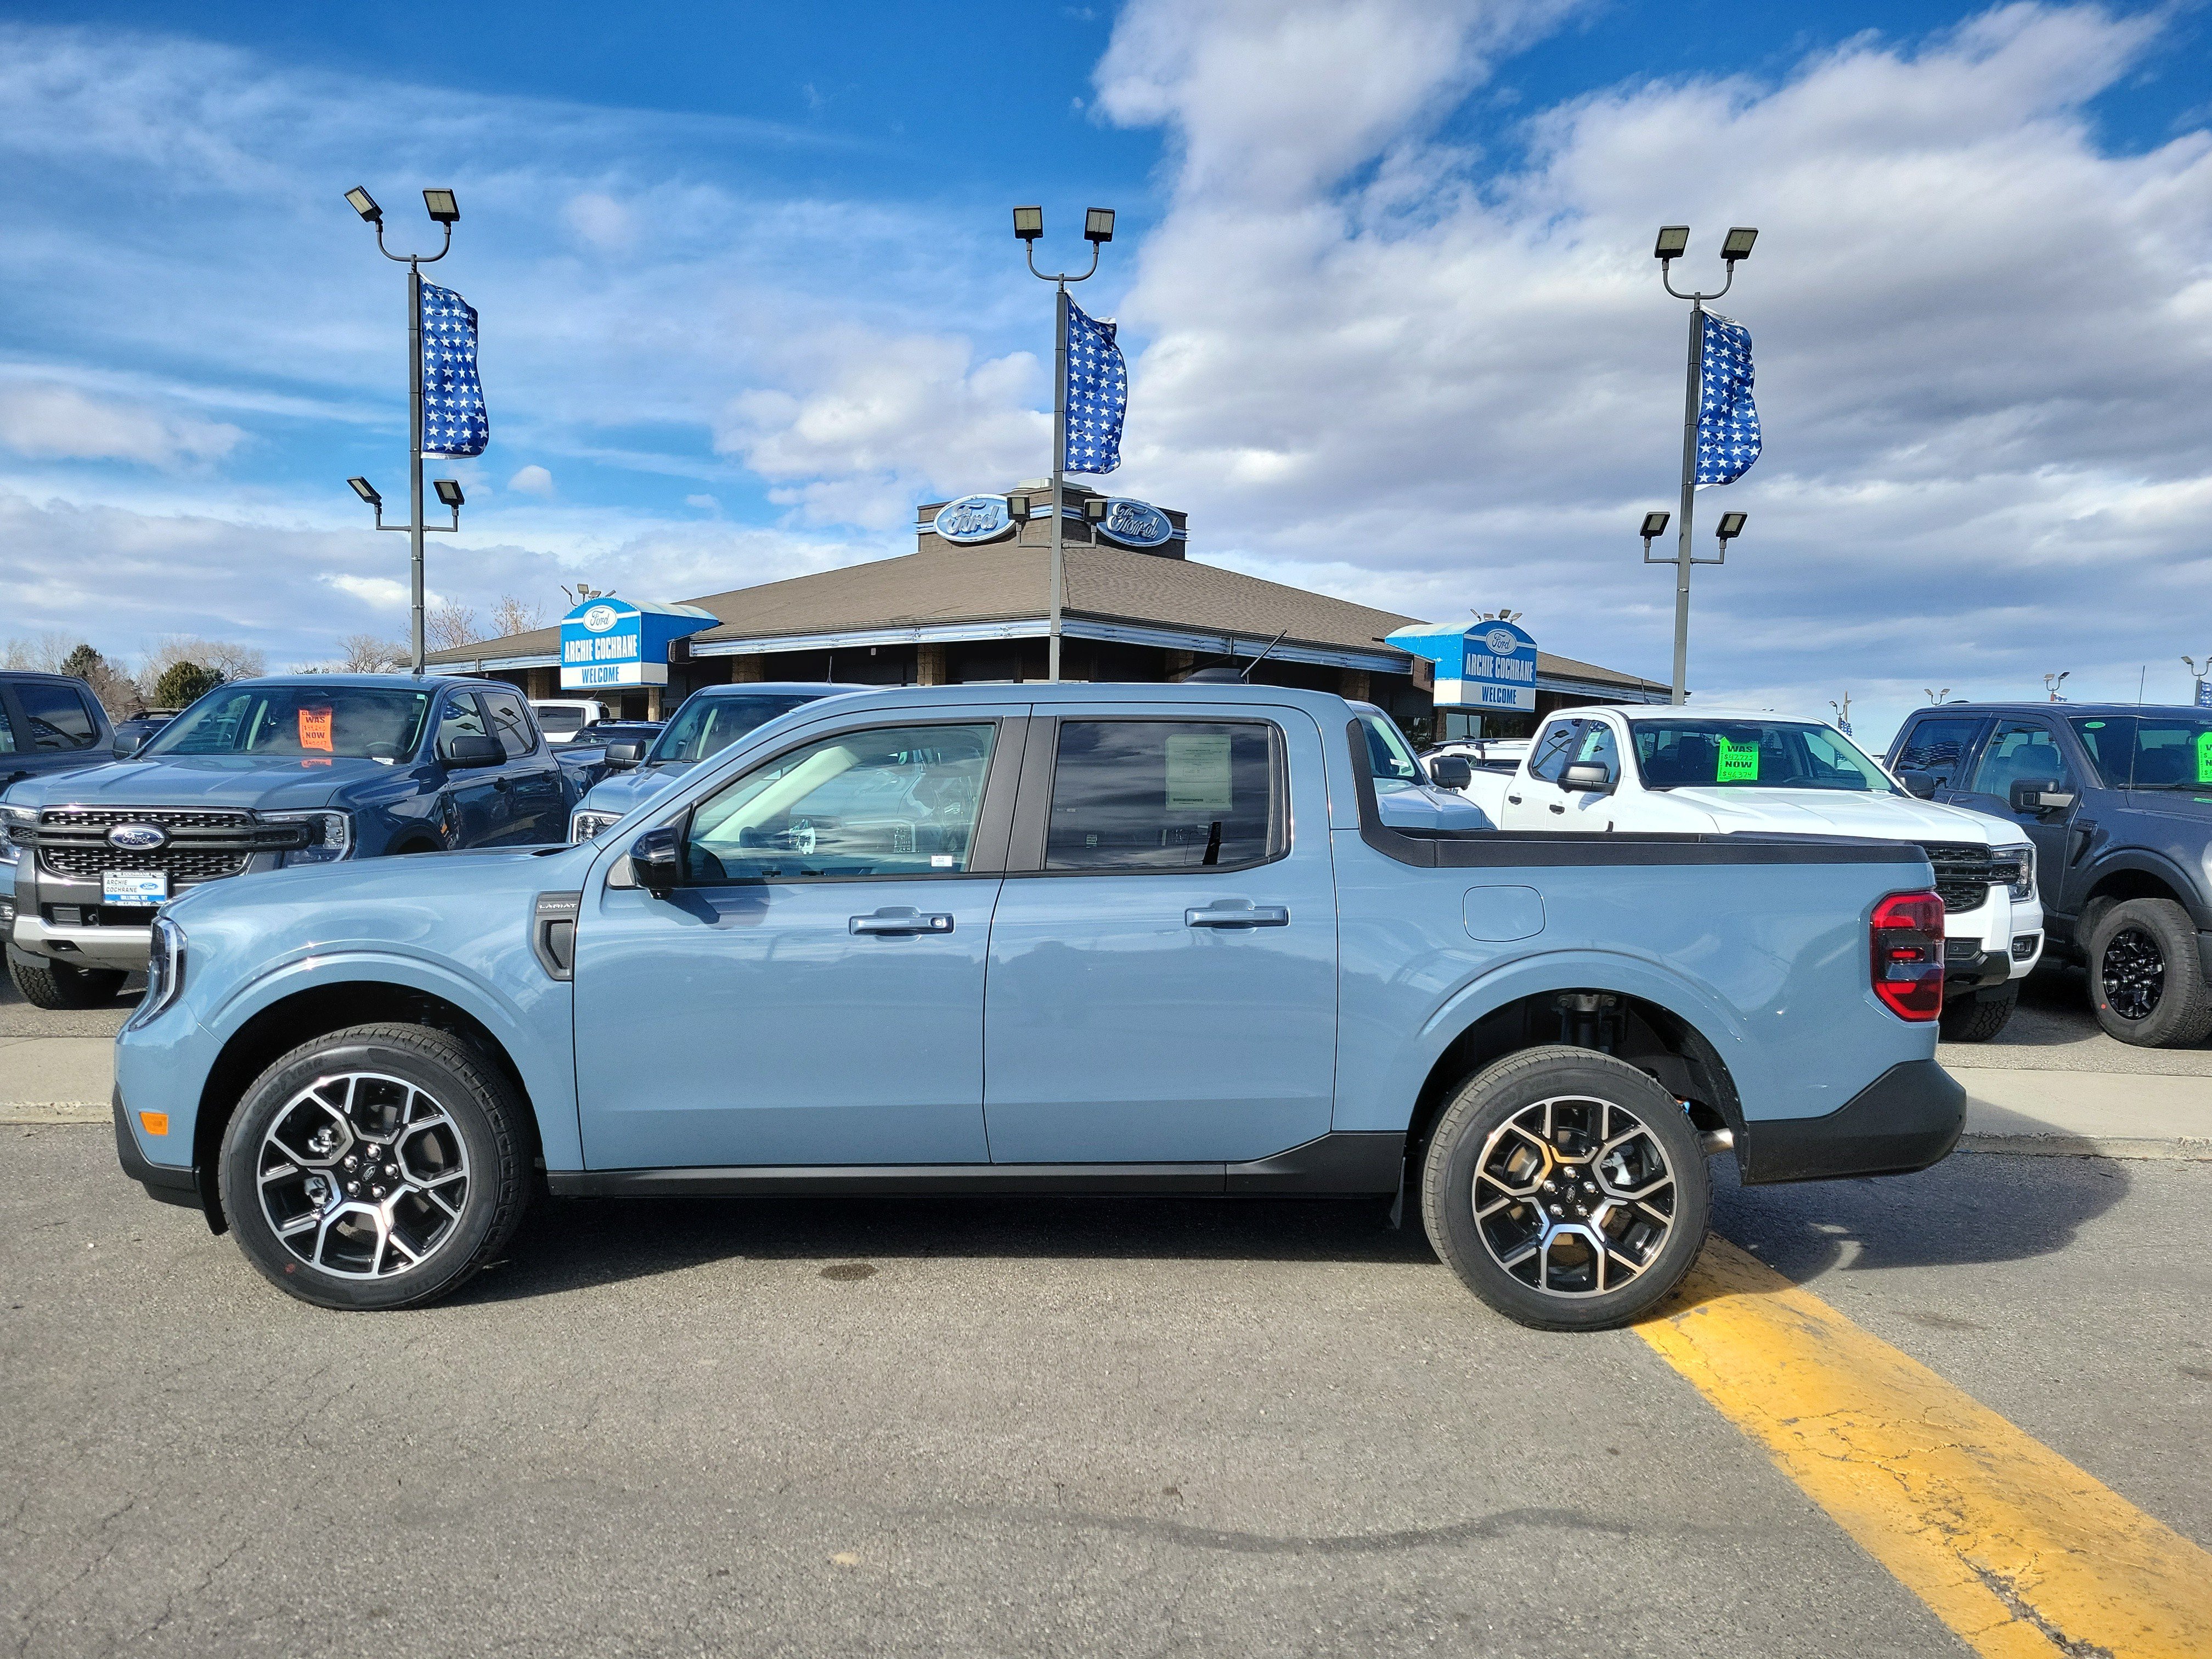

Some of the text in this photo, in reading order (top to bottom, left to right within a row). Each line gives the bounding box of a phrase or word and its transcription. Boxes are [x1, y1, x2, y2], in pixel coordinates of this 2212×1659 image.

[946, 500, 999, 534] Ford
[1108, 503, 1159, 539] Ford
[590, 611, 610, 627] Ford
[565, 634, 637, 663] ARCHIE COCHRANE
[1492, 632, 1510, 650] Ford
[582, 667, 619, 684] WELCOME
[1465, 653, 1533, 682] ARCHIE COCHRANE
[1482, 686, 1516, 705] WELCOME
[122, 832, 151, 844] Ford
